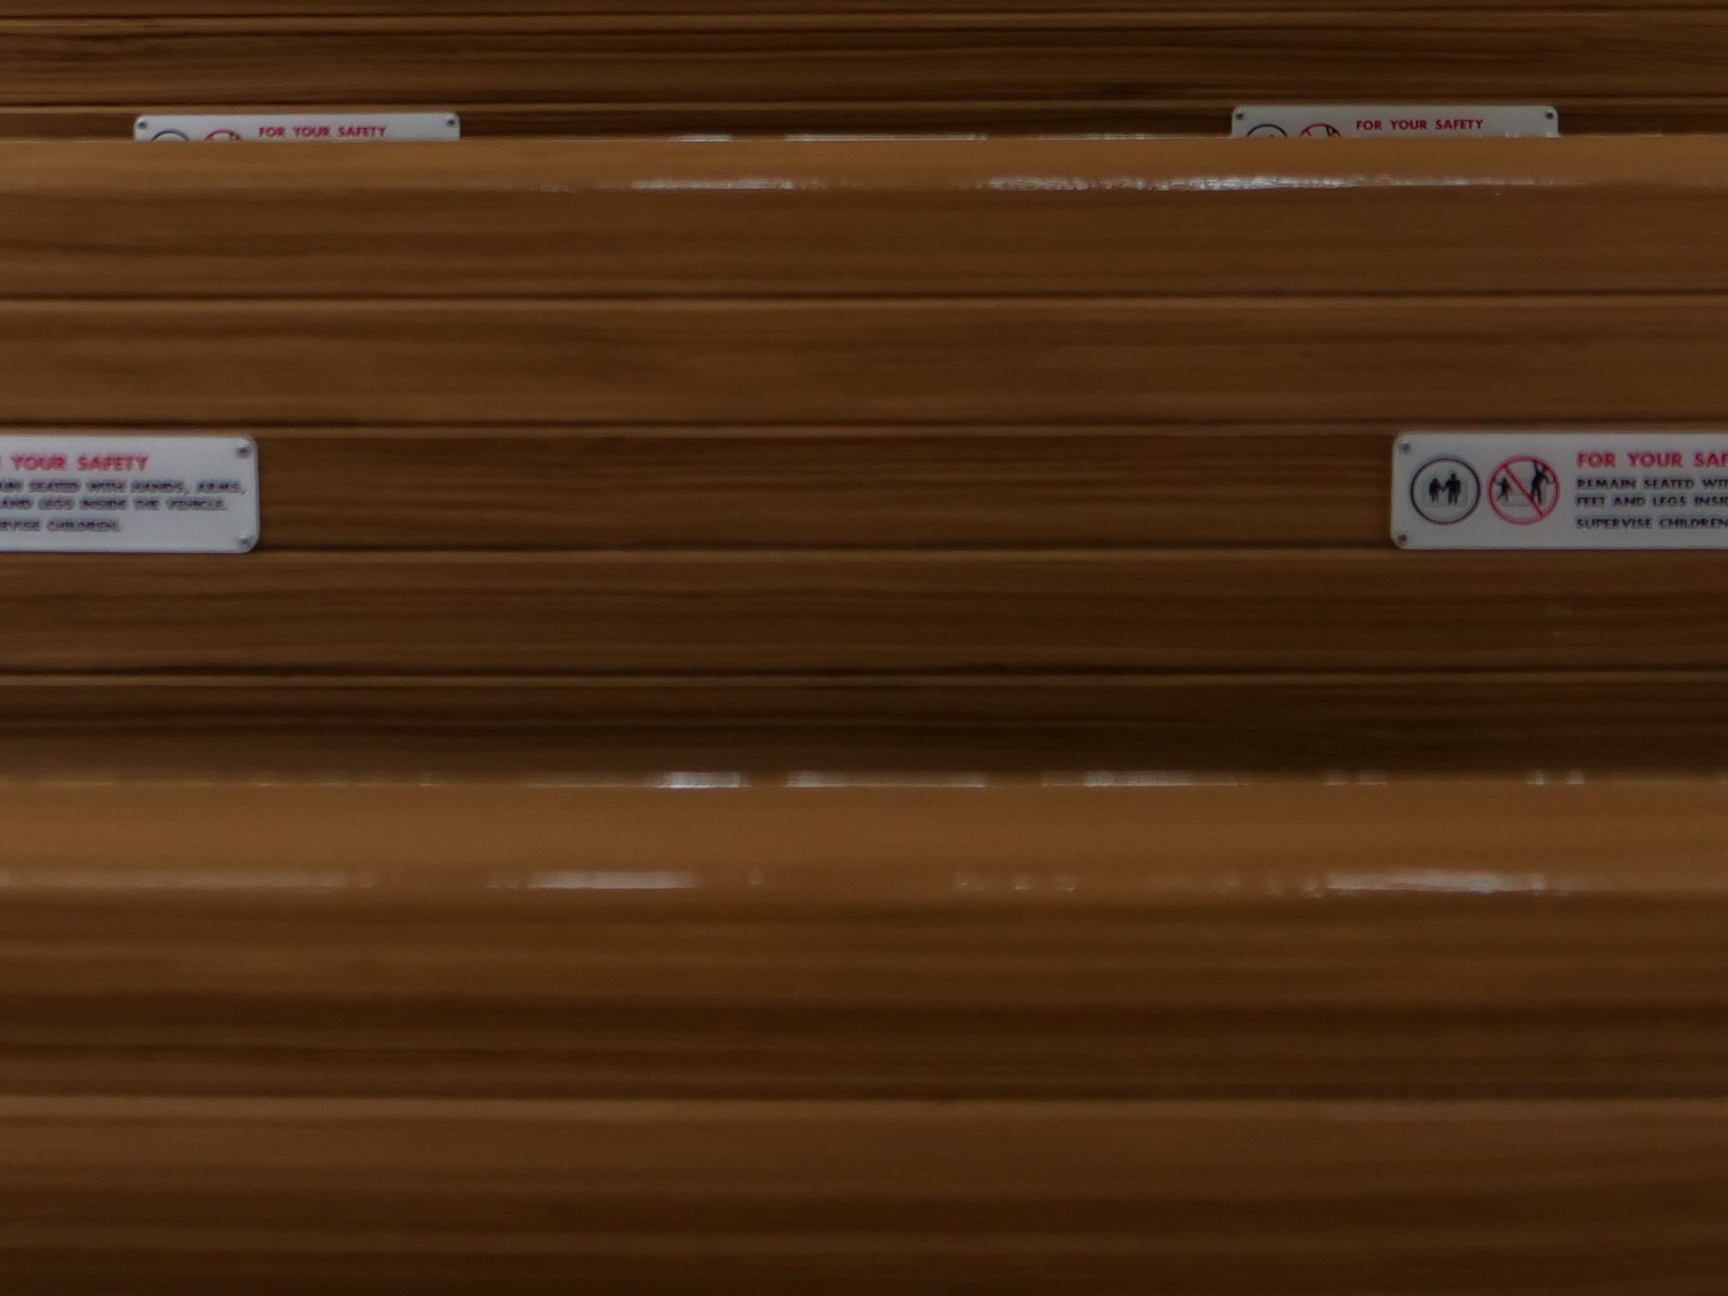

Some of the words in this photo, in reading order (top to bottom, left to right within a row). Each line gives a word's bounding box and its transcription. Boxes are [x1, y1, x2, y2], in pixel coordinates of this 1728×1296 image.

[258, 125, 285, 138] FOR
[292, 125, 330, 138] YOUR
[338, 125, 388, 138] SAFETY
[1355, 119, 1383, 131] FOR
[1389, 119, 1428, 131] YOUR
[1435, 119, 1484, 131] SAFETY
[10, 454, 67, 471] YOUR
[76, 454, 150, 471] SAFETY
[1576, 451, 1616, 468] FOR
[1628, 451, 1683, 468] YOUR
[1576, 477, 1636, 490] REMAIN
[1643, 477, 1695, 490] SEATED
[1576, 495, 1606, 507] FEET
[1613, 495, 1646, 507] AND
[1652, 495, 1687, 507] LEGS
[1576, 516, 1652, 529] SUPERVISE
